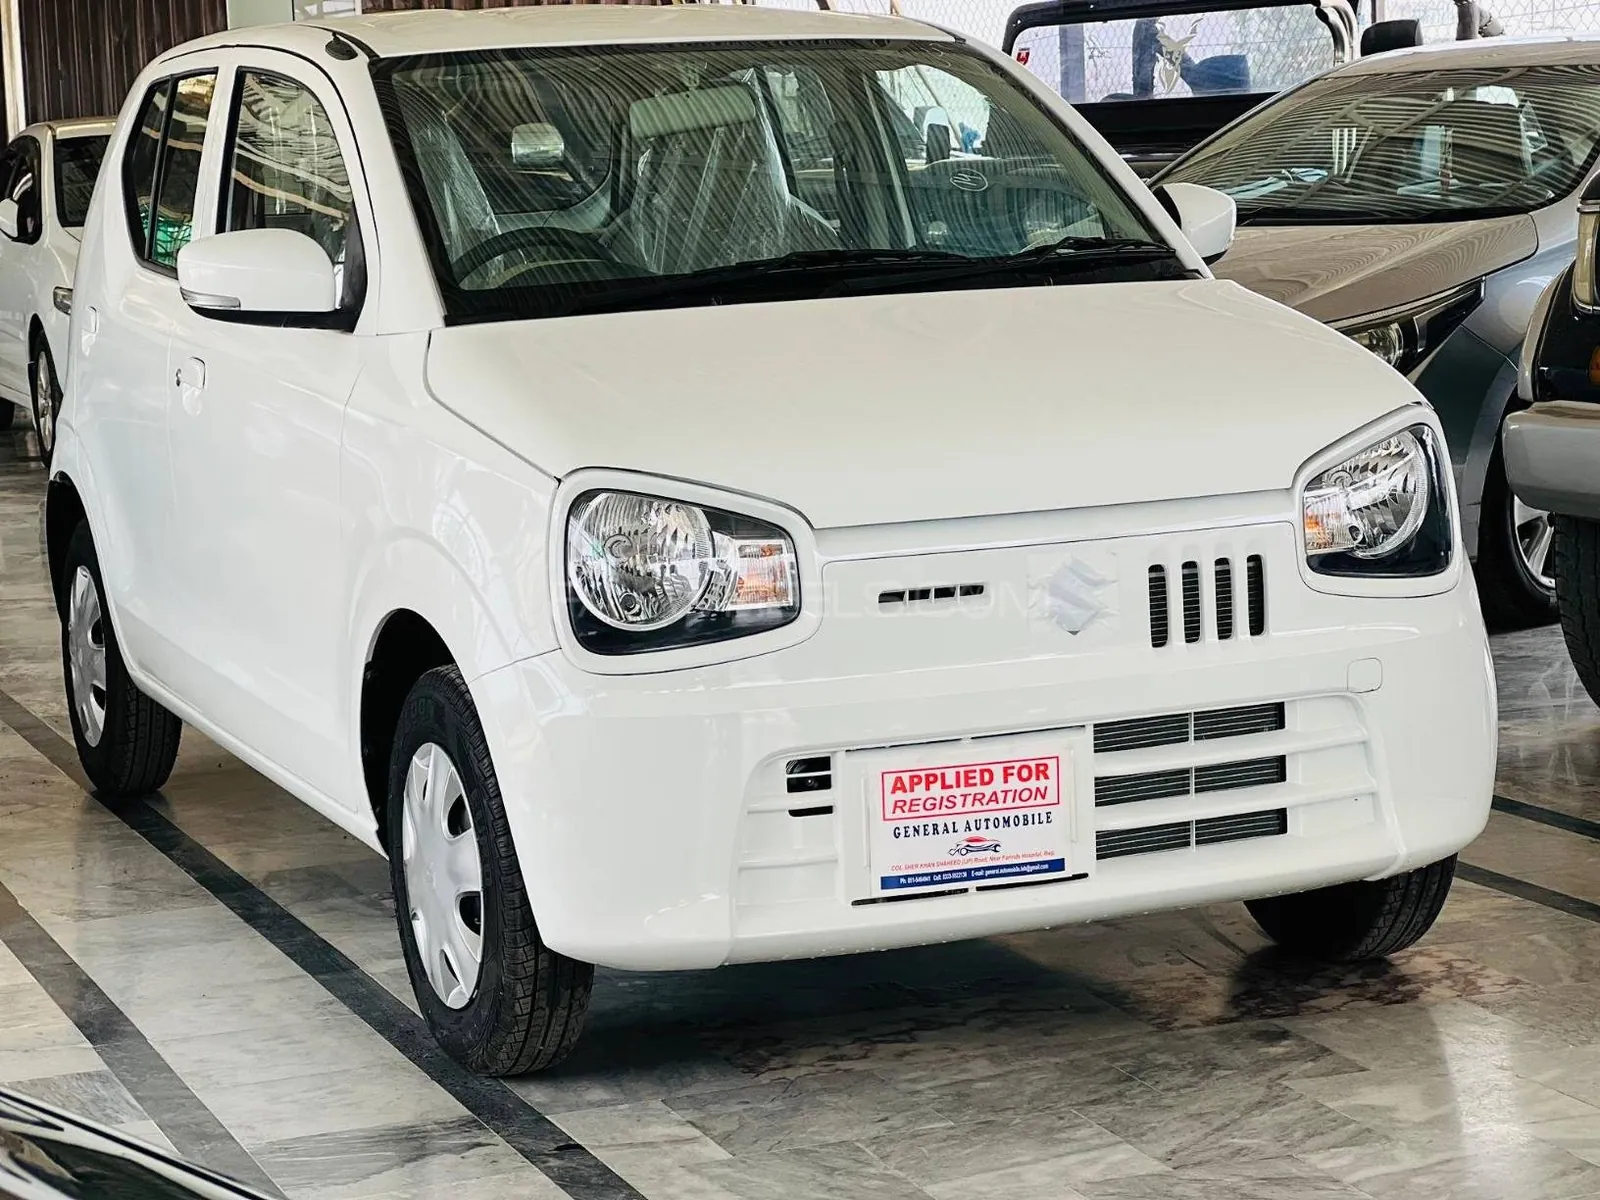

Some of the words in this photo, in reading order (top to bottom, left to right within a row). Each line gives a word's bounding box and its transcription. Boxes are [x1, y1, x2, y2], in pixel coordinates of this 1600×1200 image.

[891, 767, 994, 794] APPLIED
[1002, 763, 1050, 783] FOR
[891, 785, 1048, 815] REGISTRATION
[893, 820, 958, 840] GENERAL
[964, 811, 1053, 832] AUTOMOBILE
